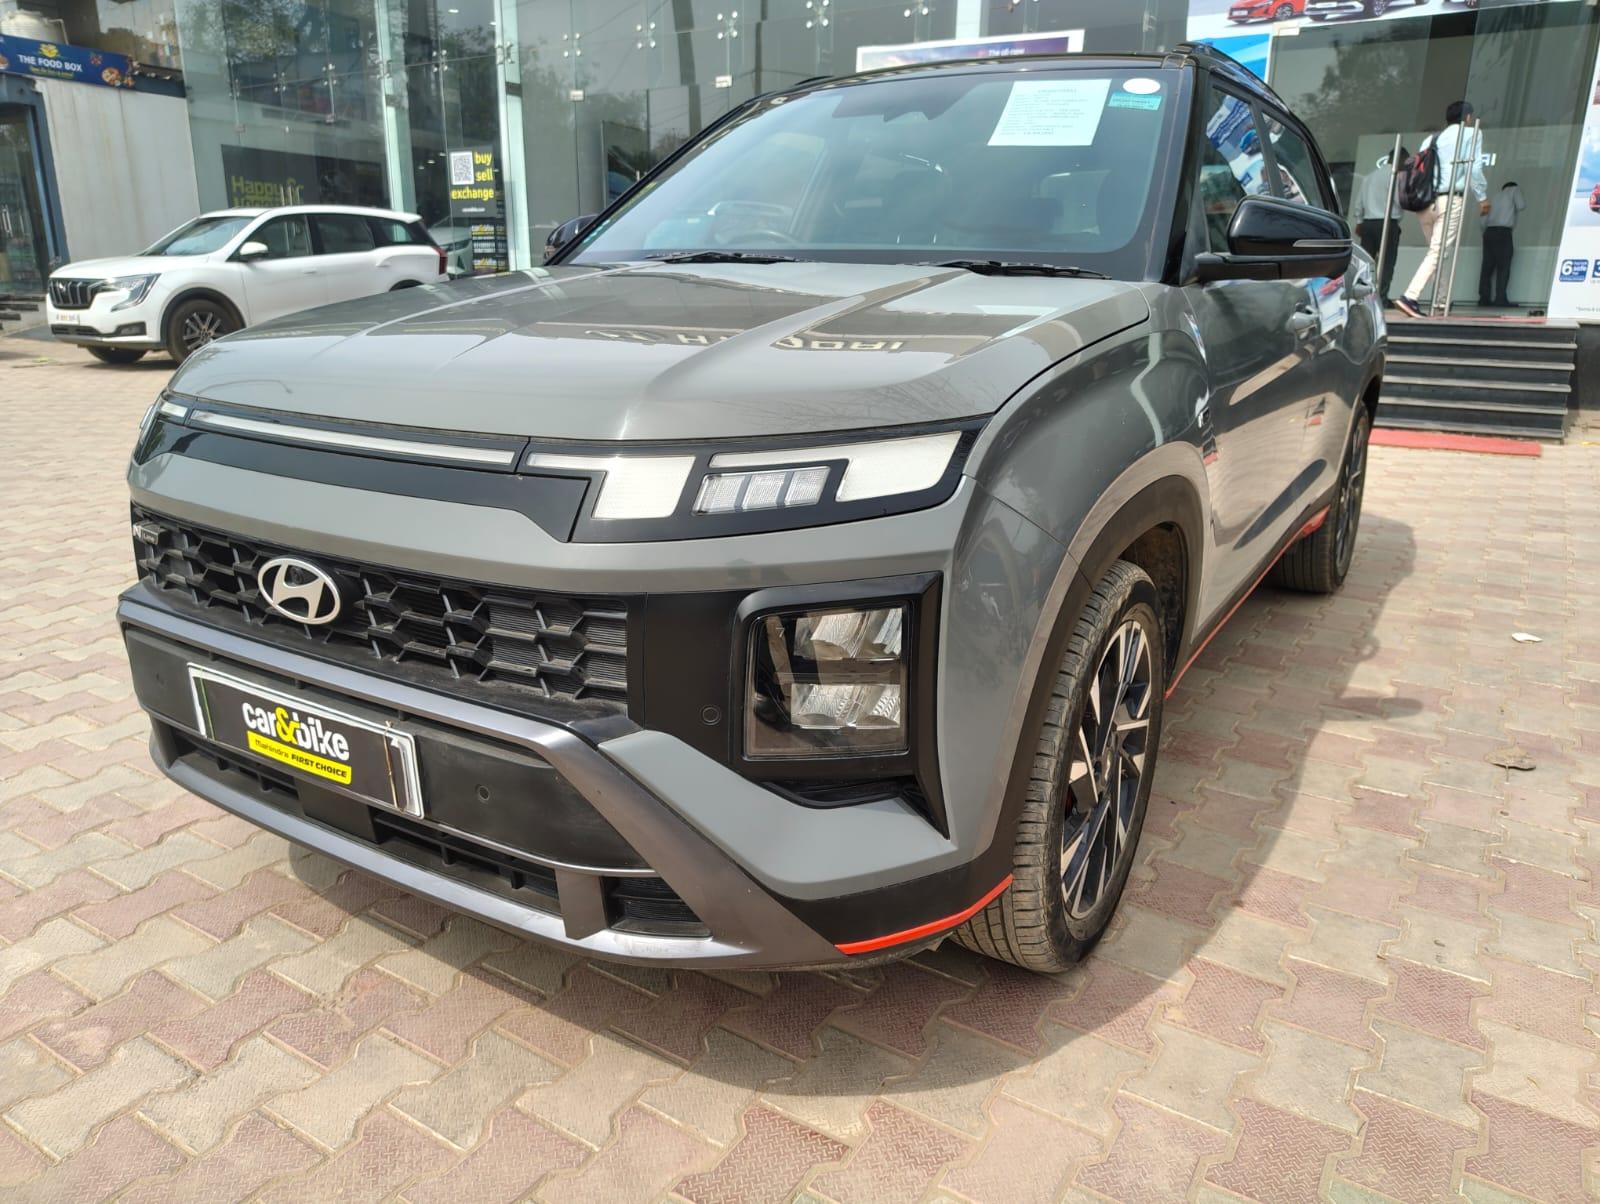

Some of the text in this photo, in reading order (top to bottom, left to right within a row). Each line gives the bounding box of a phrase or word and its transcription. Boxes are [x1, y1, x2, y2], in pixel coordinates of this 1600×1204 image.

[17, 54, 36, 65] THE
[38, 57, 63, 69] FOOD
[64, 61, 83, 72] BOX
[474, 151, 492, 166] buy
[475, 167, 493, 182] sell
[451, 186, 494, 201] exchange
[1562, 261, 1573, 275] 6
[241, 702, 350, 761] car&bike
[291, 753, 315, 768] FIRST
[315, 761, 348, 779] CHOICE
